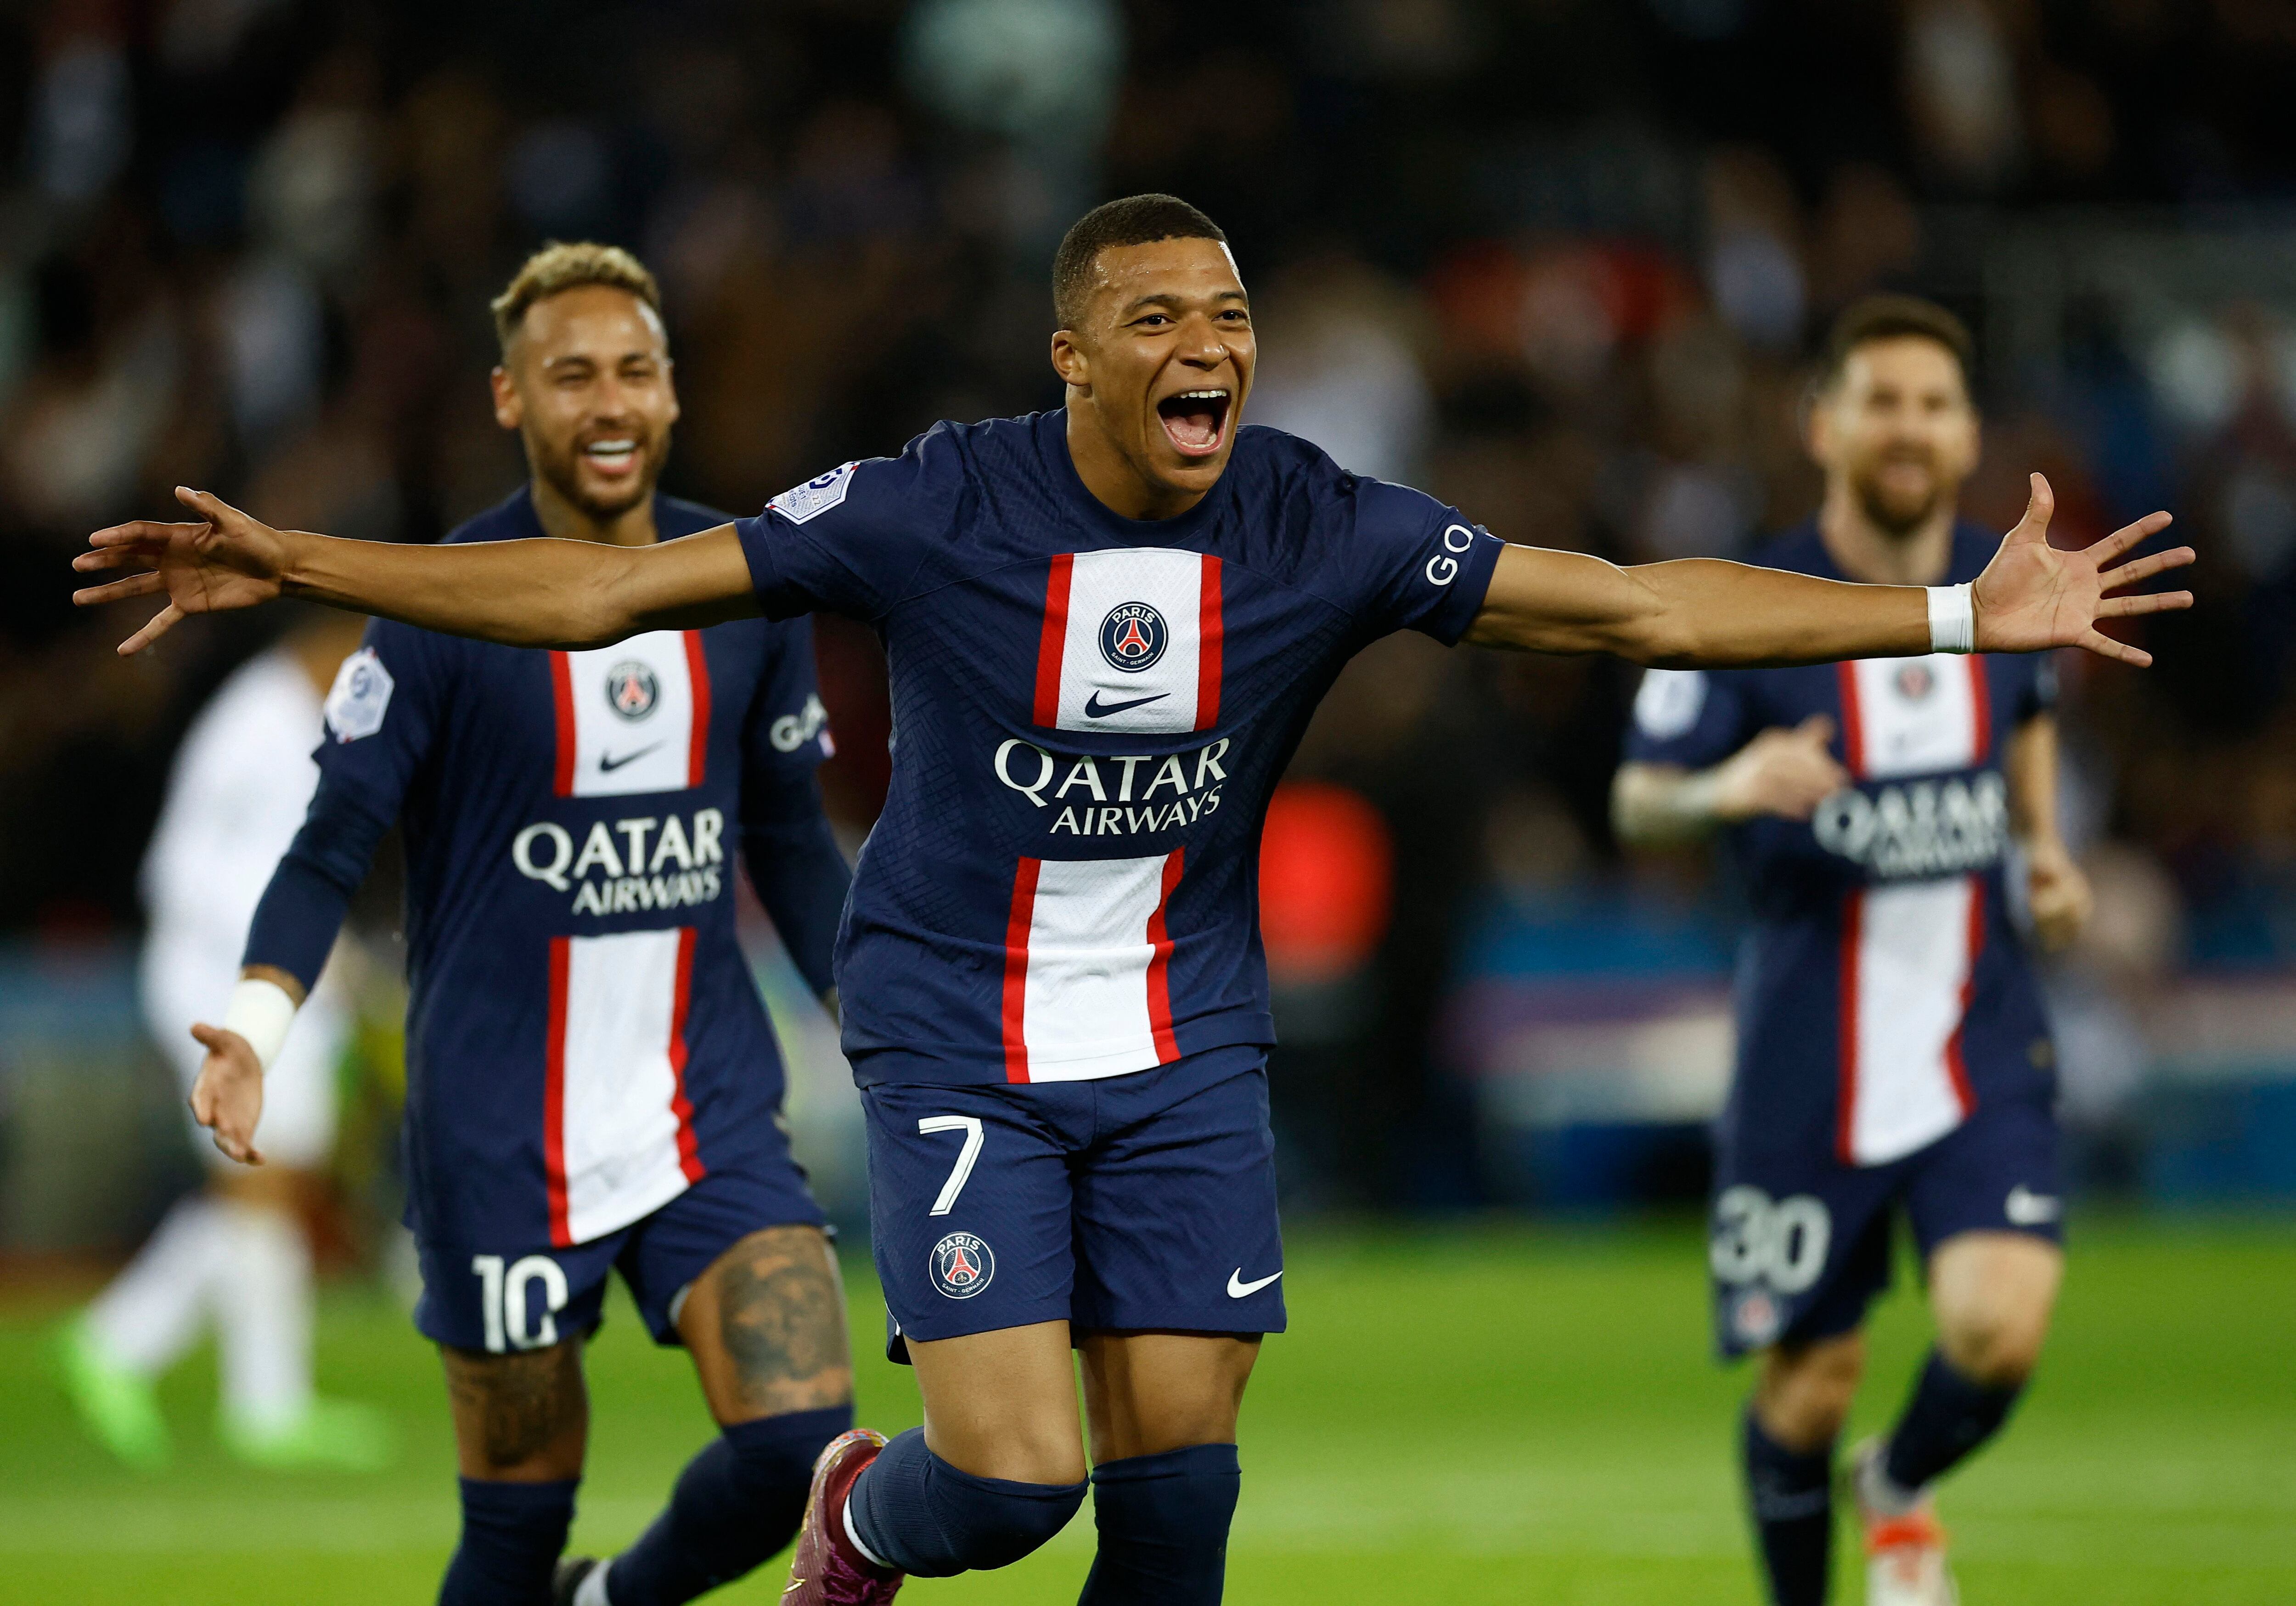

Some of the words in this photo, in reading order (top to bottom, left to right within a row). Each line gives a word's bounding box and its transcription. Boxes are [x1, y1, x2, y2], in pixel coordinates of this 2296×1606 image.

[1112, 607, 1155, 623] PARIS
[994, 738, 1230, 808] QATAR
[1049, 784, 1222, 835] AIRWAYS
[512, 807, 724, 892] QATAR
[571, 865, 721, 916] AIRWAYS
[918, 1115, 984, 1216] 7
[937, 1236, 980, 1255] PARIS
[471, 1254, 568, 1353] 10
